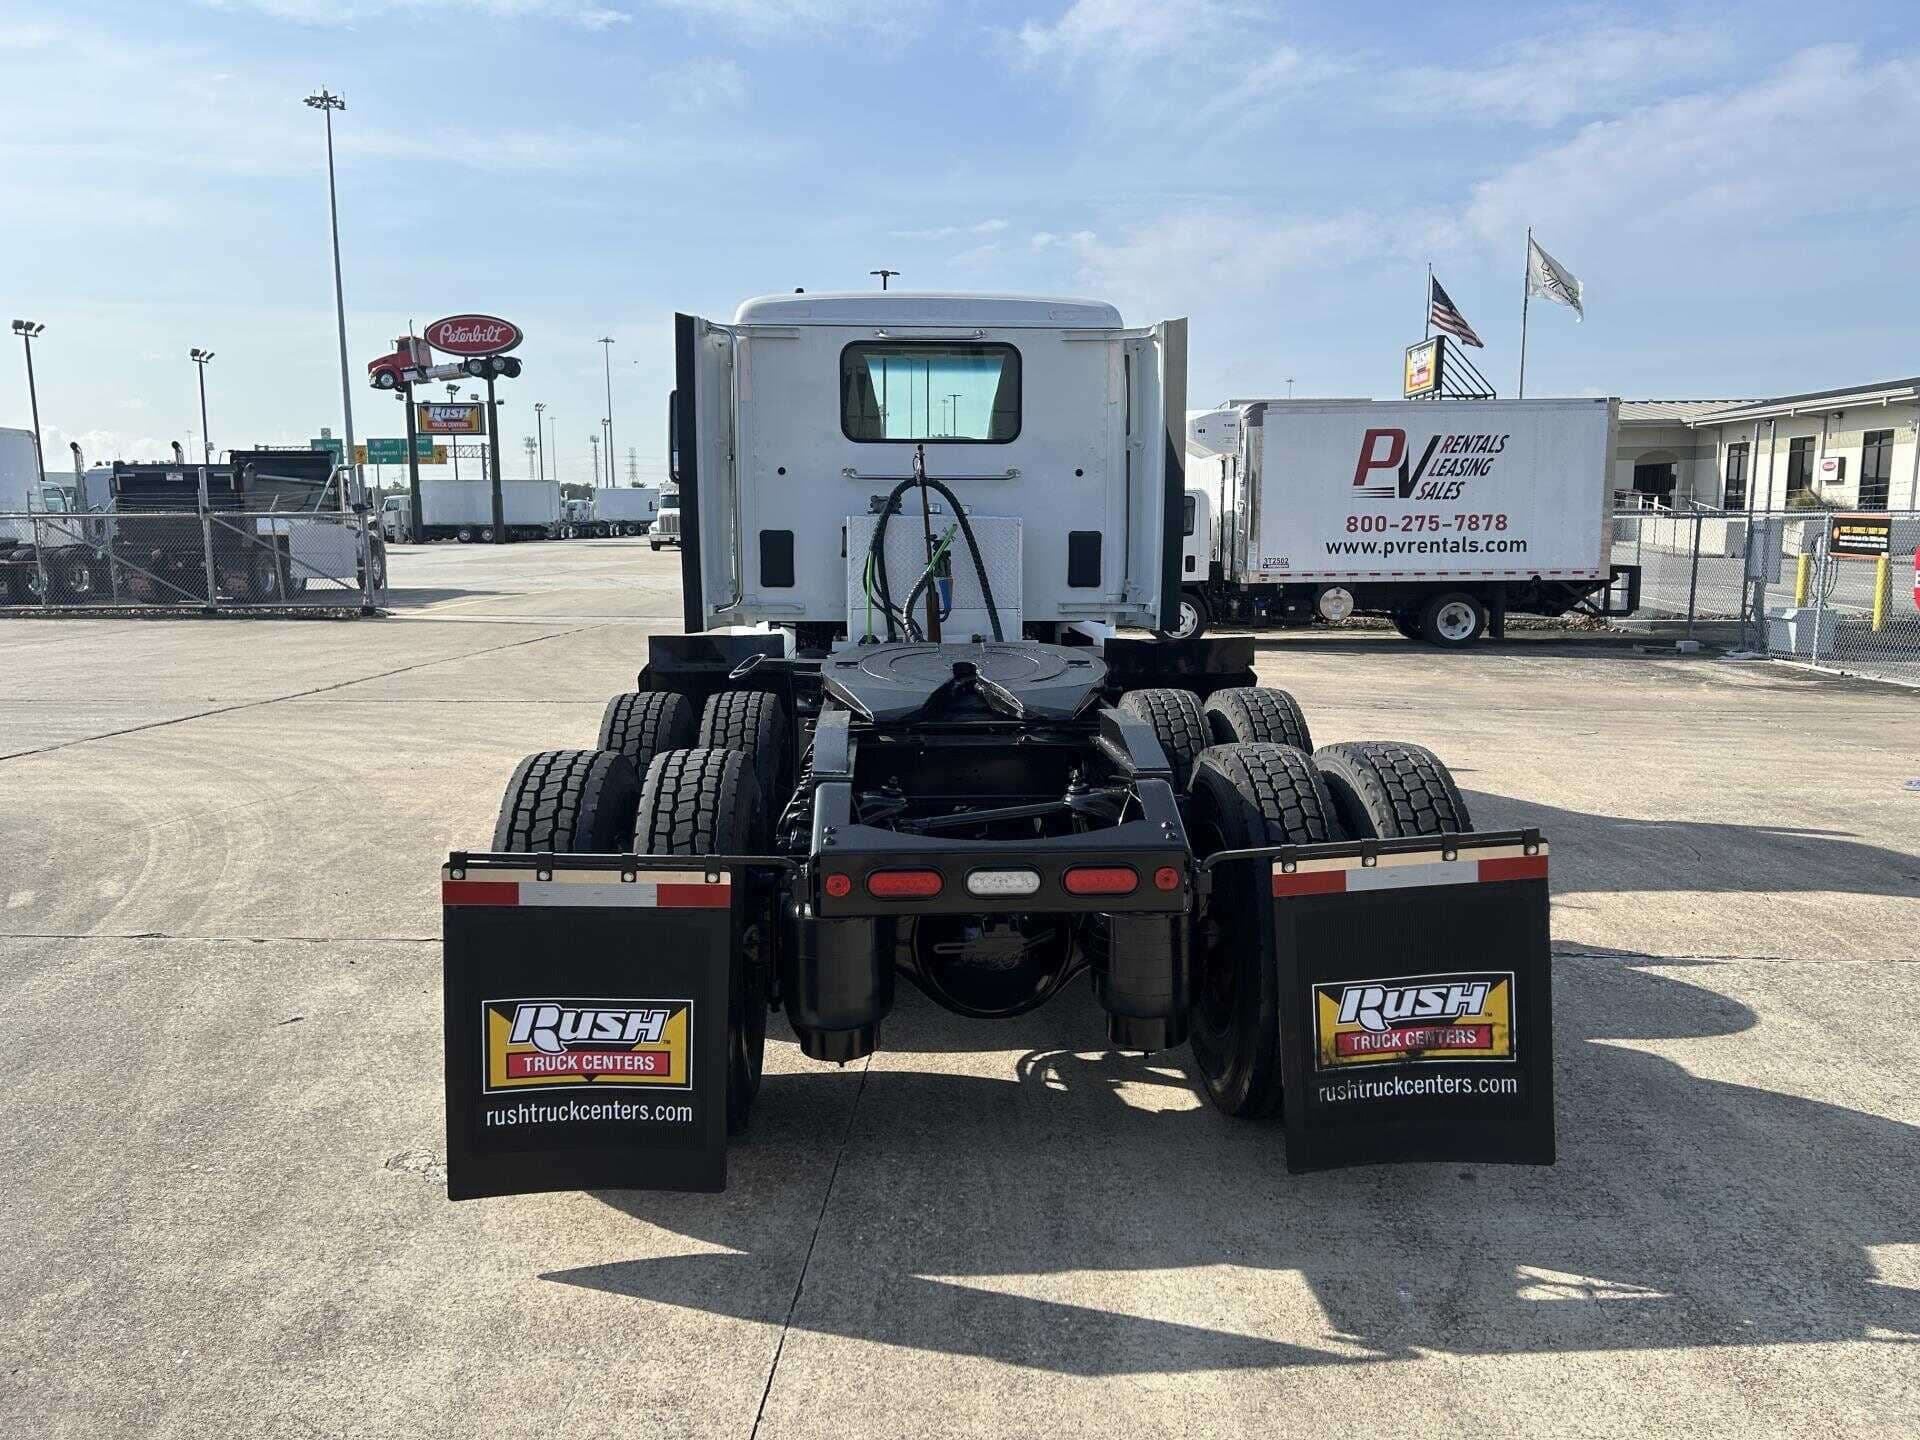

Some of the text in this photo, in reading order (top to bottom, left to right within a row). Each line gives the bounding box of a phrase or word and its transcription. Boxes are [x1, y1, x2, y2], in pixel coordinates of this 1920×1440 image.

[439, 323, 507, 345] Peterbilt
[428, 407, 472, 421] RUSH
[1440, 434, 1510, 453] RENTALS
[1353, 428, 1442, 499] PV
[1428, 457, 1495, 477] LEASING
[1415, 481, 1465, 500] SALES
[1346, 514, 1508, 533] 800-275-7878
[1326, 537, 1528, 559] www.pvrentals.com
[1336, 981, 1491, 1033] RUSH
[507, 1003, 670, 1055] RUSH
[1350, 1029, 1477, 1051] TRUCK CENTERS
[524, 1055, 655, 1072] TRUCK CENTERS
[1319, 1074, 1518, 1103] rushtruckcenters.com
[486, 1100, 693, 1126] rushtruckcenters.com
